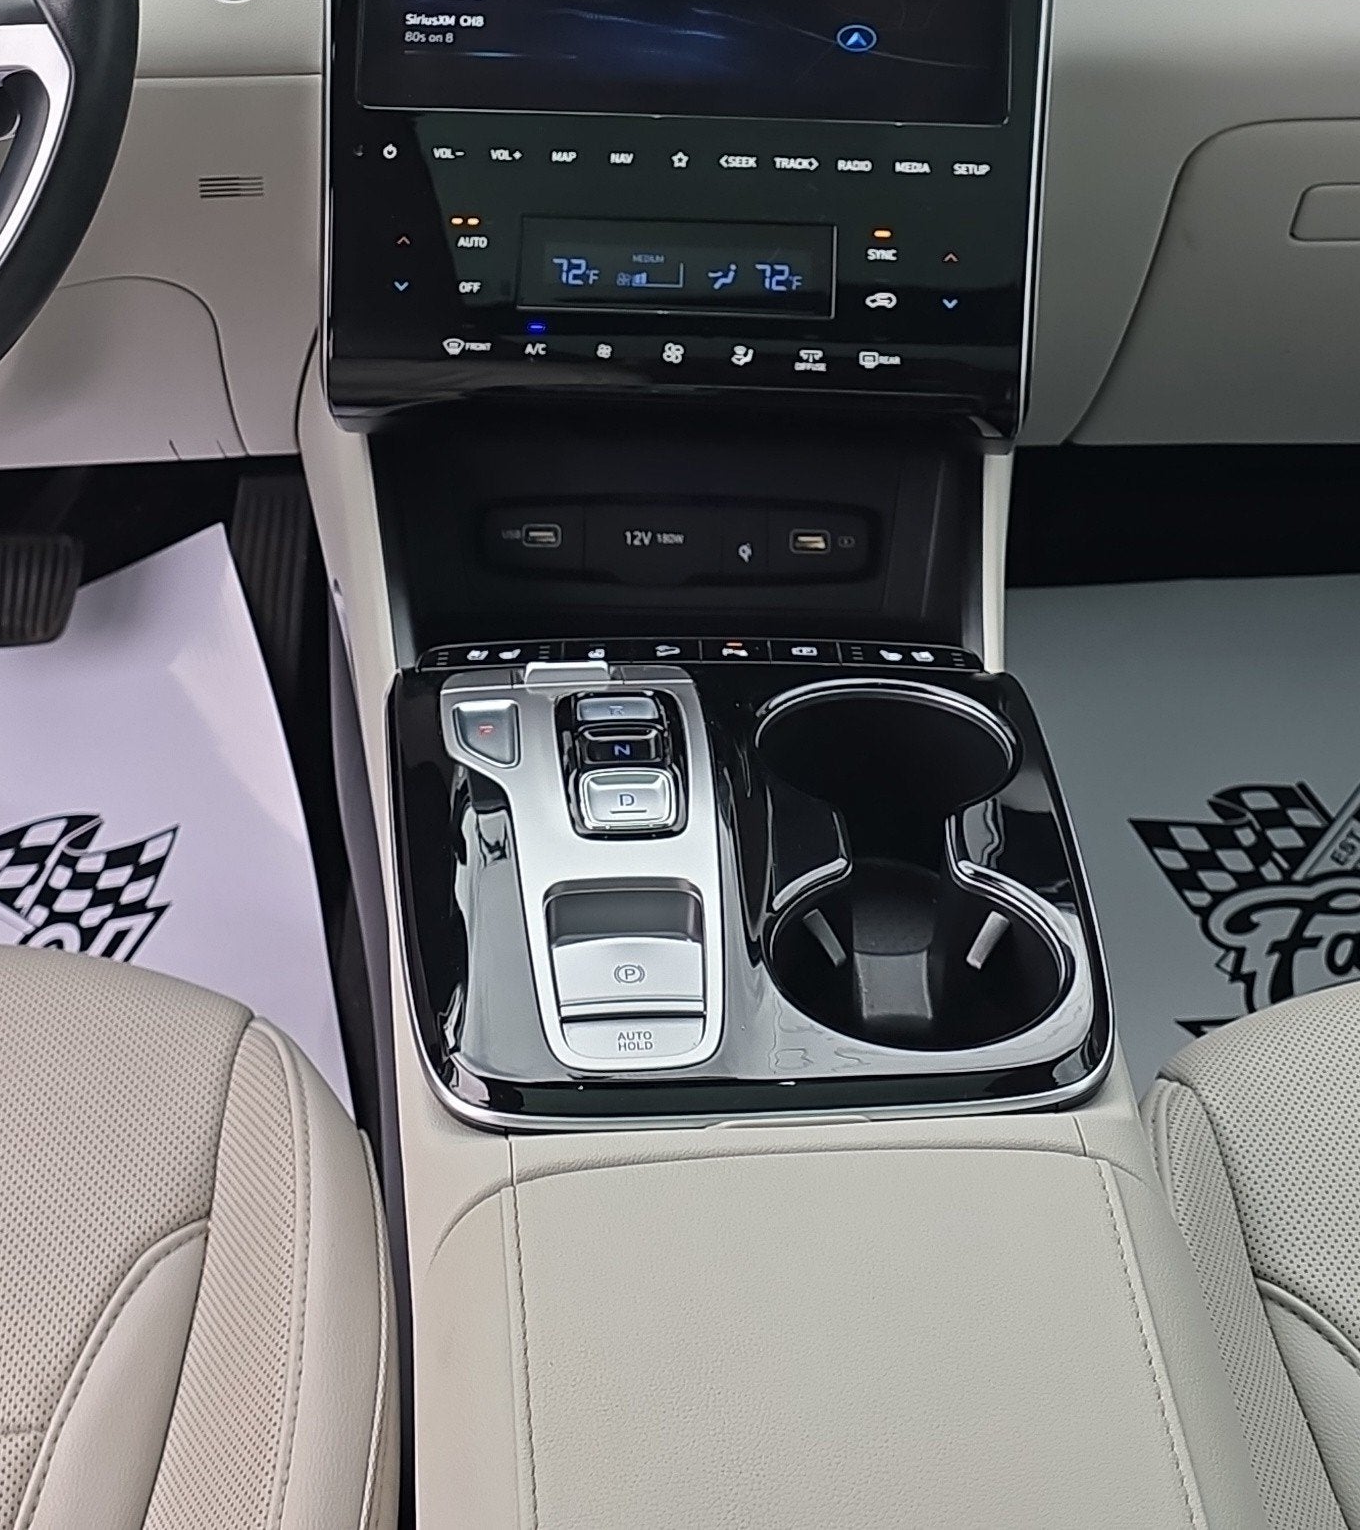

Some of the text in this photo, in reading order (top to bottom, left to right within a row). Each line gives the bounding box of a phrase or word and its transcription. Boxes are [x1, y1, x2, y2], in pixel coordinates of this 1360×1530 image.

[405, 13, 485, 28] SiriusXM CH8
[404, 31, 454, 43] 80s on 8
[551, 151, 577, 163] MAP
[609, 152, 634, 164] NAV
[837, 159, 873, 172] RADIO
[894, 161, 931, 174] MEDIA
[953, 163, 990, 176] SETUP
[457, 236, 488, 249] AUTO
[632, 253, 665, 264] MEDIUM
[866, 248, 898, 261] SYNC
[458, 281, 482, 294] OFF
[465, 342, 492, 352] FRONT
[524, 343, 547, 355] A/C
[624, 530, 686, 547] 12V 180W
[614, 743, 632, 756] N
[619, 792, 636, 807] D
[617, 1030, 653, 1041] AUTO
[617, 1041, 654, 1052] HOLD
